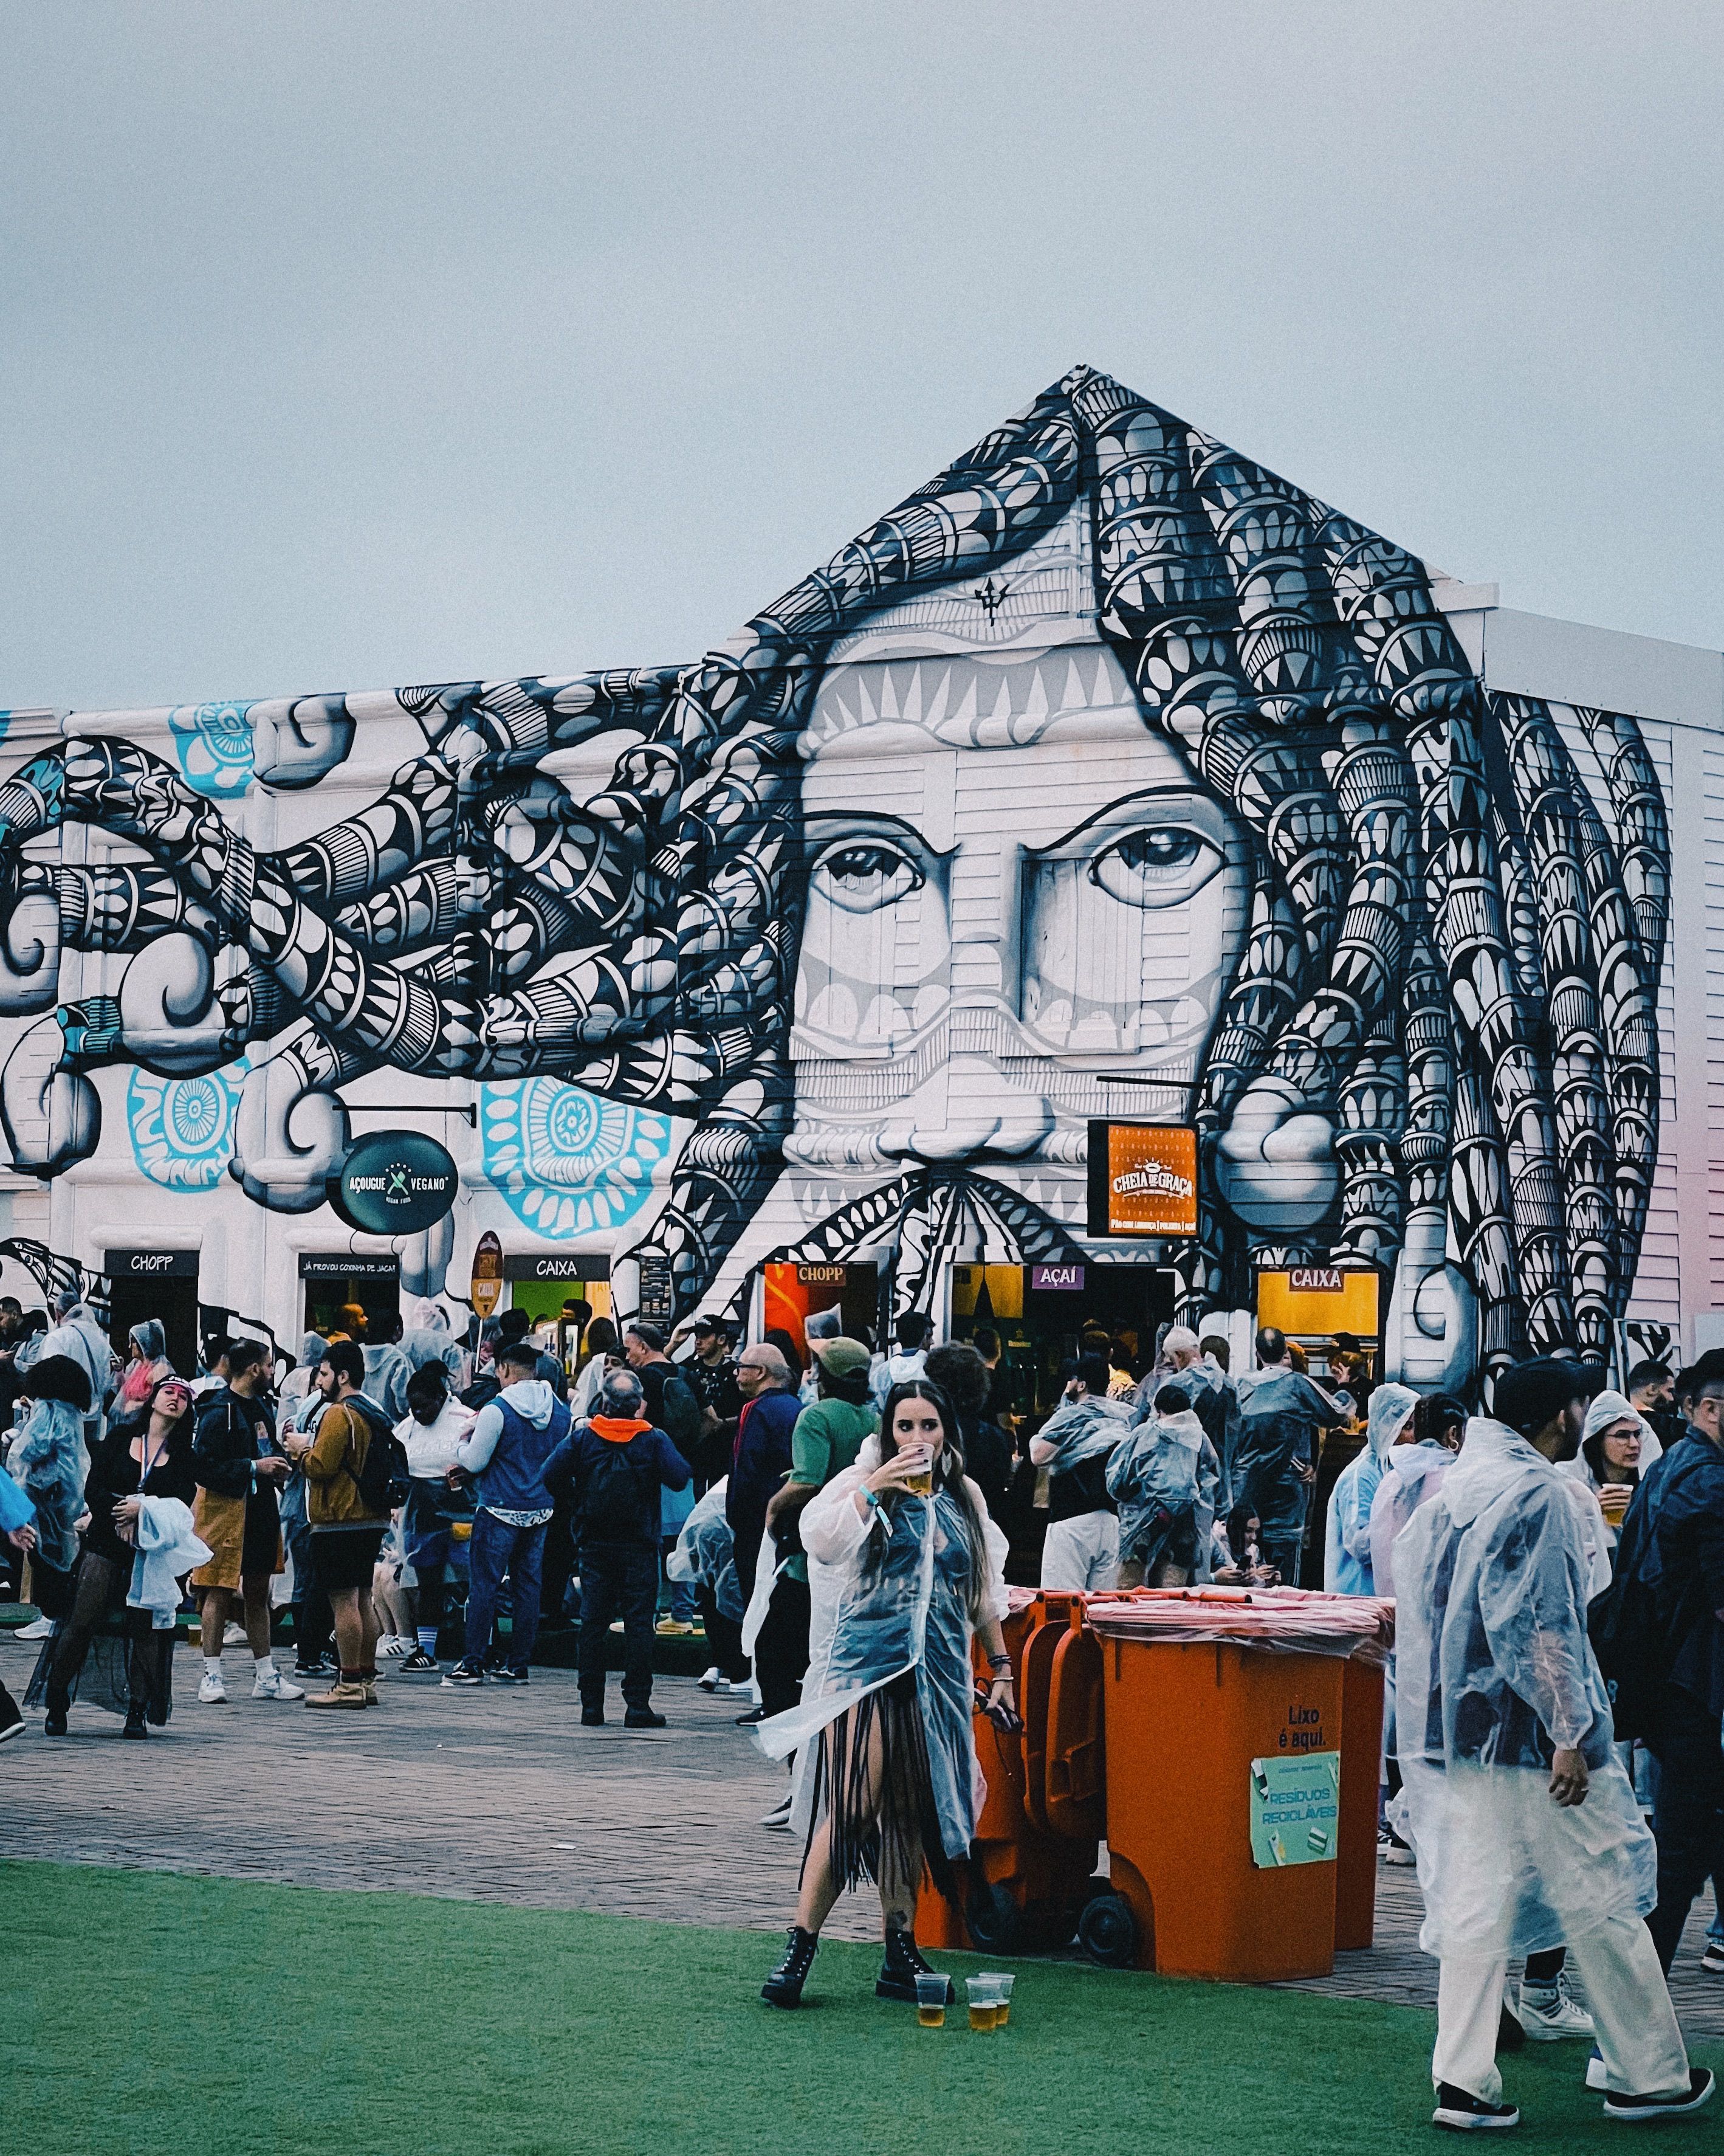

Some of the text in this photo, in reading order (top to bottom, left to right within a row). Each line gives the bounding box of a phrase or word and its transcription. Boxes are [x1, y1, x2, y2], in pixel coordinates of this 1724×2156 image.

[349, 1177, 386, 1194] AÇOUGUE
[1113, 1172, 1192, 1197] CHEIA DE GRAÇA
[131, 1255, 174, 1271] CHOPP
[536, 1259, 577, 1276] CAIXA
[798, 1267, 843, 1281] CHOPP
[1040, 1266, 1076, 1287] AÇAÍ
[1291, 1269, 1342, 1287] CAIXA
[1288, 1705, 1319, 1725] Lixo
[1279, 1726, 1327, 1752] é aqui.
[1269, 1787, 1330, 1805] RESÍDUOS
